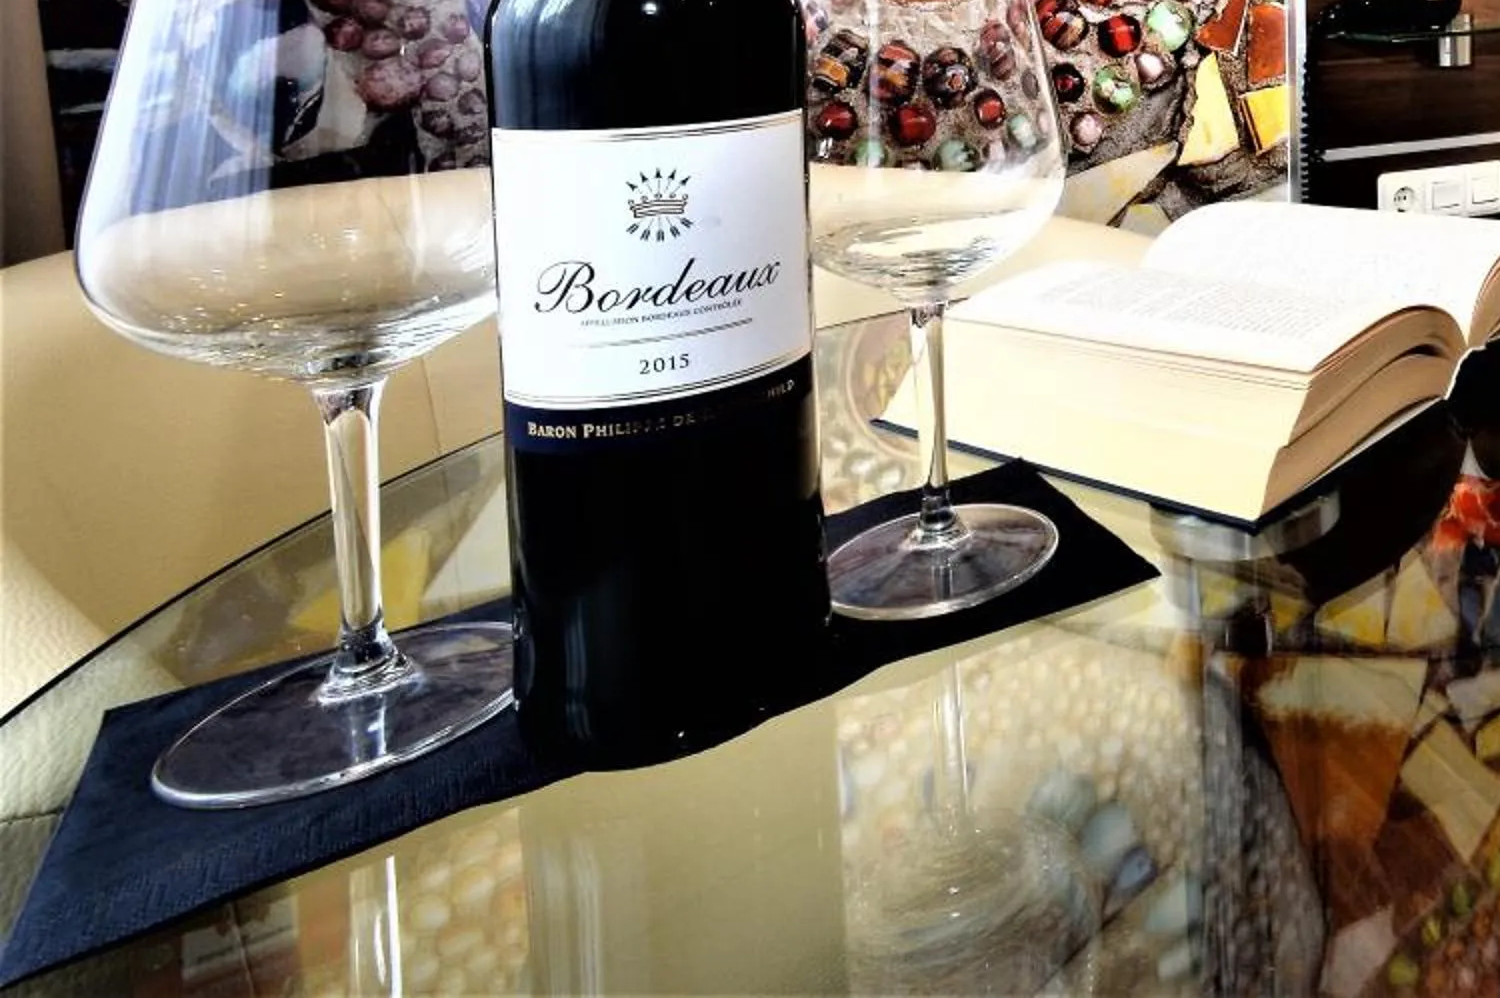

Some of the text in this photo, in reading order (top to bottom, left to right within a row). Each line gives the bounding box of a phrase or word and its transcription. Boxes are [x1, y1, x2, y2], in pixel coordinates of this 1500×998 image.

[534, 257, 781, 315] Bordeaux
[638, 353, 690, 375] 2015
[527, 421, 577, 439] BARON
